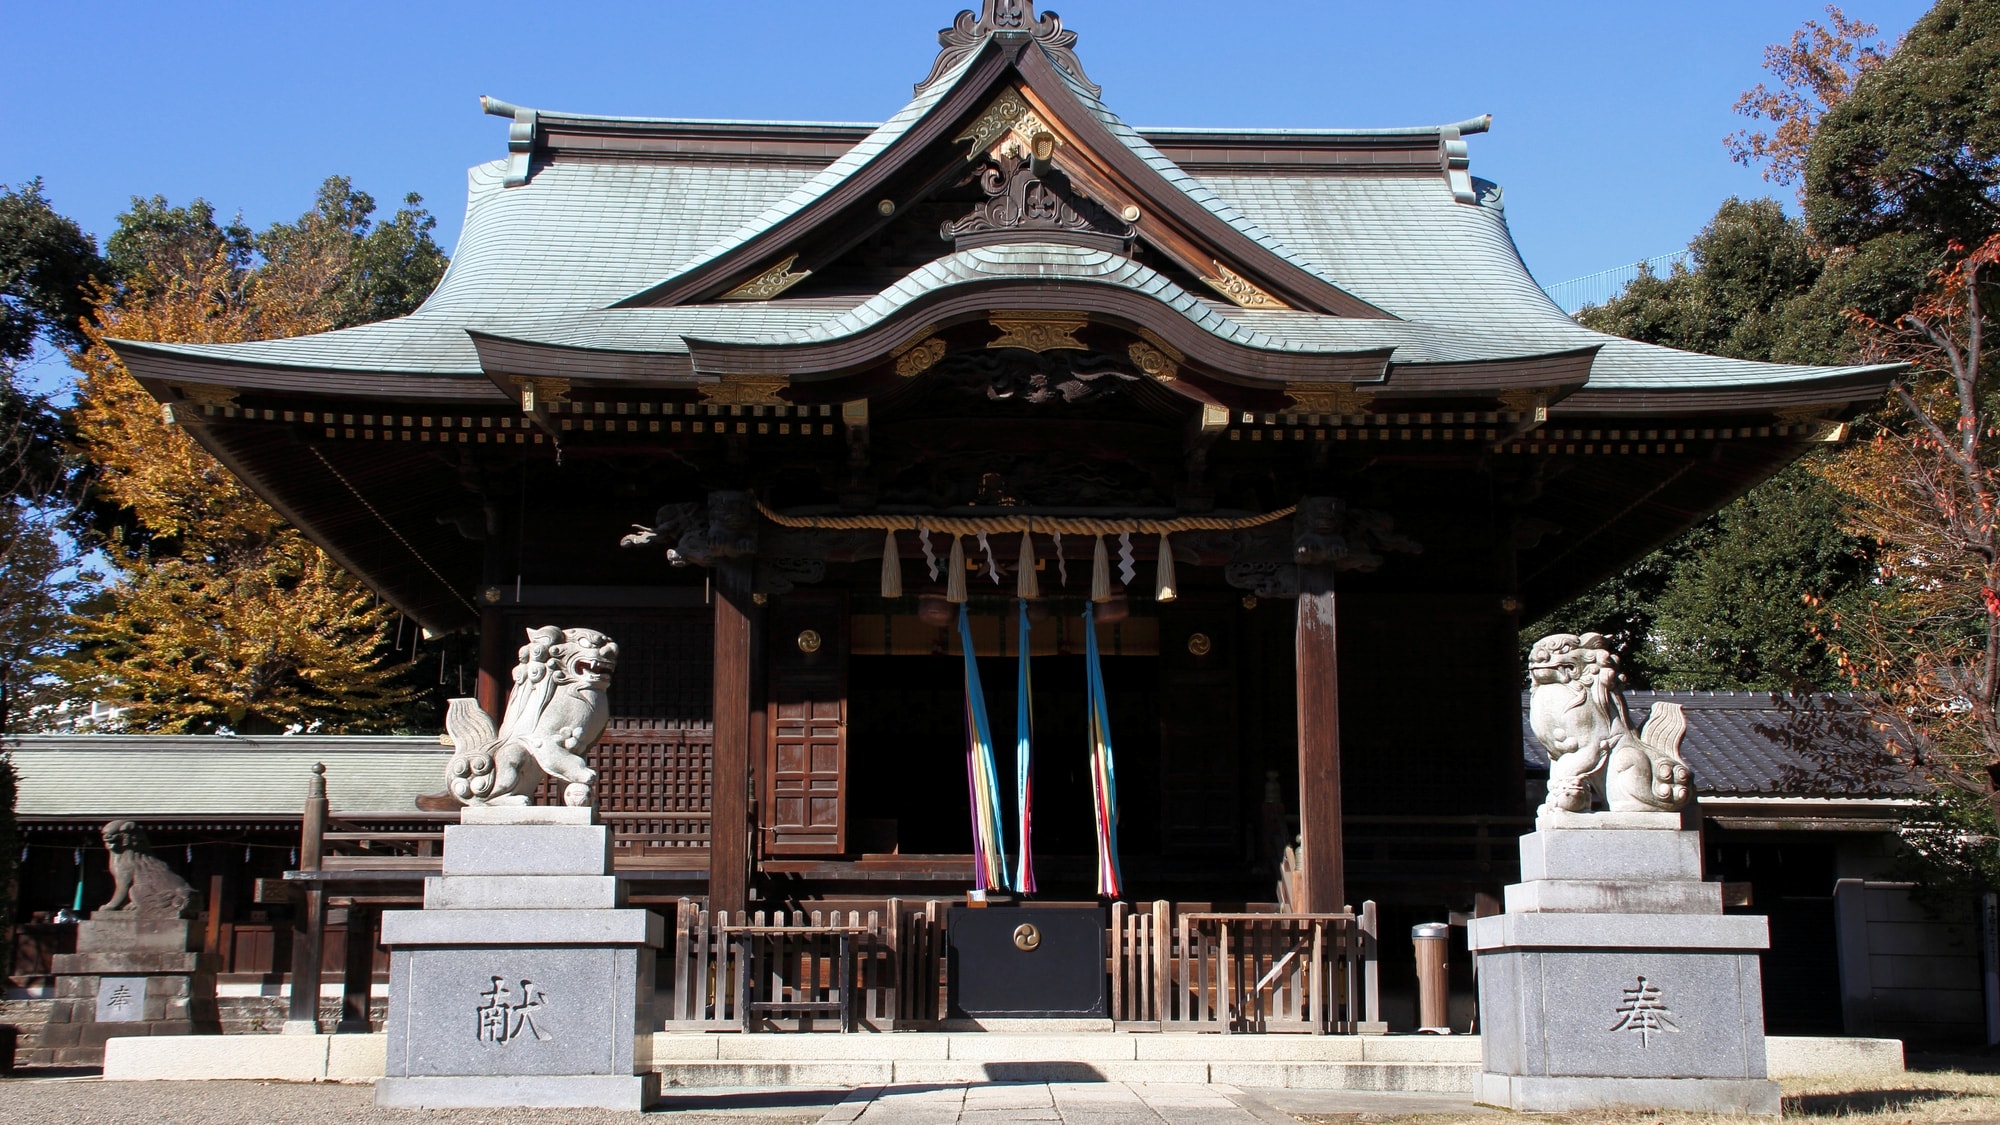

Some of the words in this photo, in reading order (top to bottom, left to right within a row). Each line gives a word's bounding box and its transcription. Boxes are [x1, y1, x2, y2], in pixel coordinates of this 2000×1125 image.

[106, 984, 134, 1012] 奉
[476, 975, 553, 1047] 献
[1609, 975, 1680, 1049] 奉
